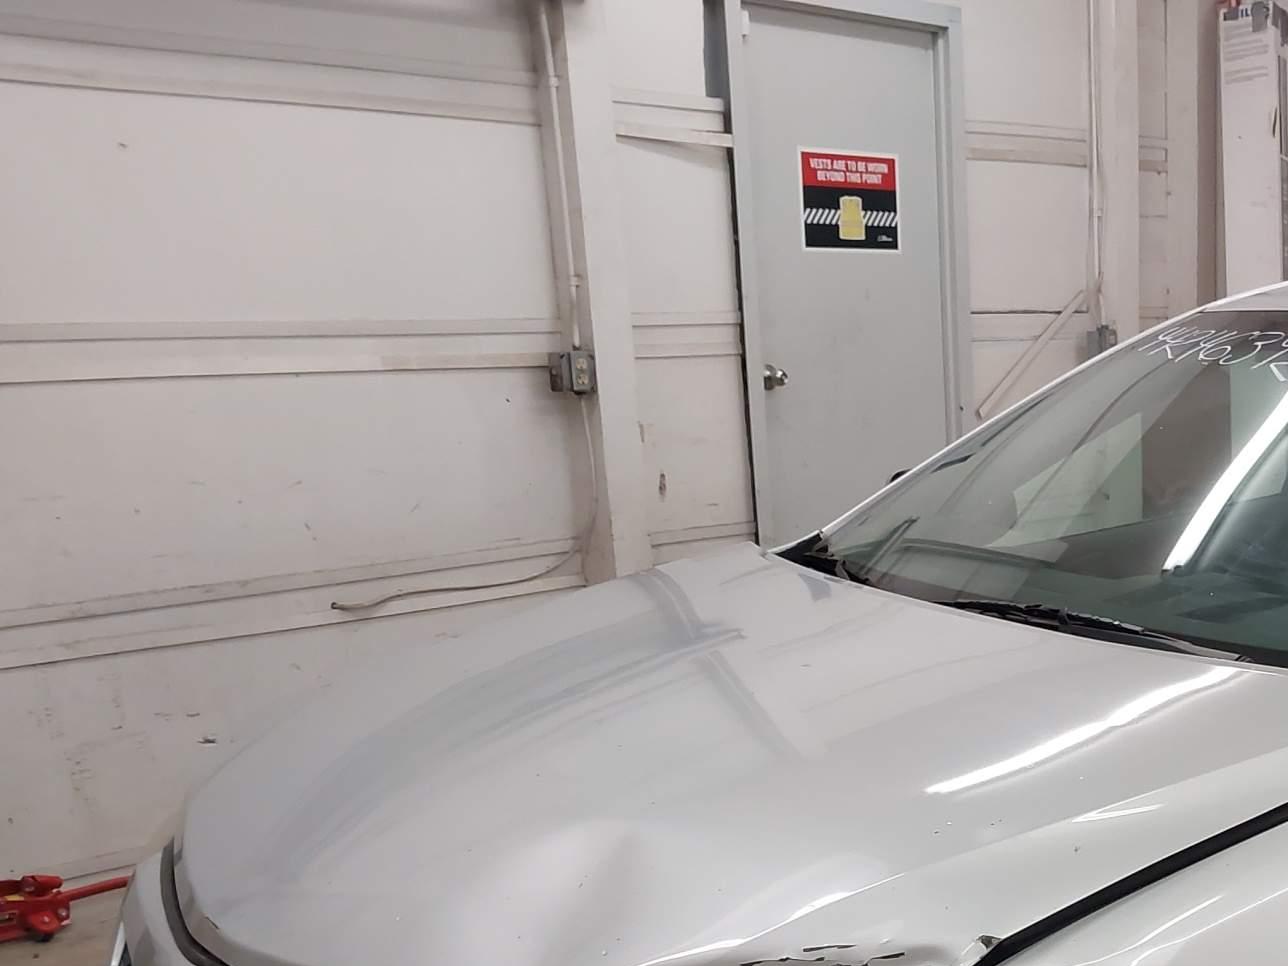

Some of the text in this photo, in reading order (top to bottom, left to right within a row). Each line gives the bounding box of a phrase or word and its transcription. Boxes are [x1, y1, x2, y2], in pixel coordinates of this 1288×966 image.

[809, 158, 888, 173] VESTS ARE TO BE WORN
[817, 171, 882, 184] BEYOND THIS POINT
